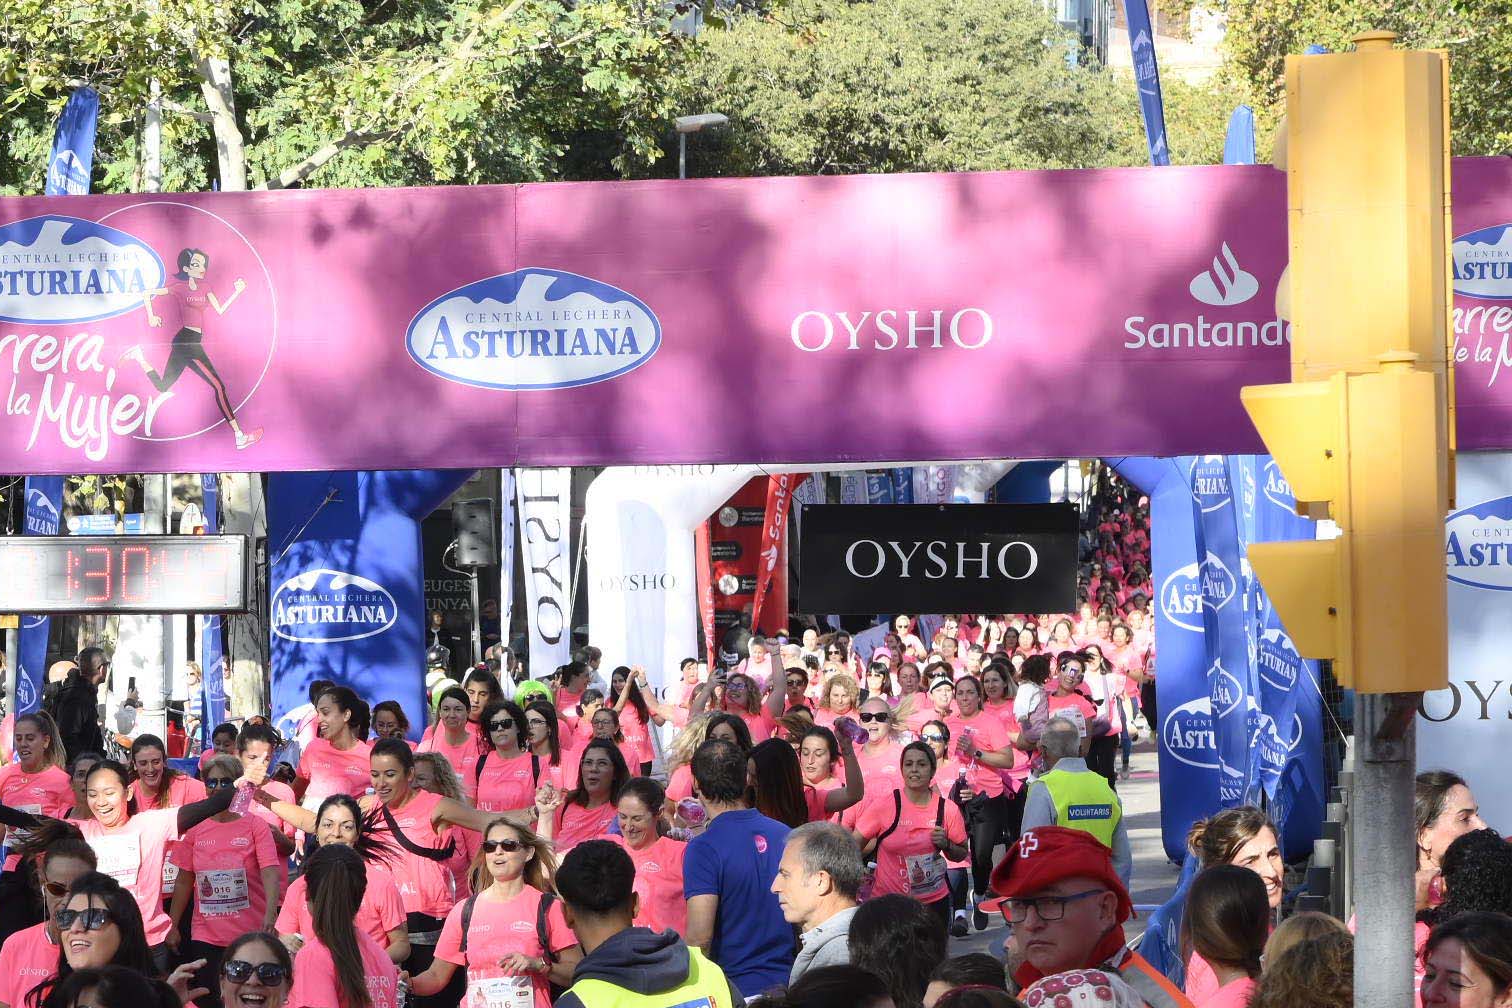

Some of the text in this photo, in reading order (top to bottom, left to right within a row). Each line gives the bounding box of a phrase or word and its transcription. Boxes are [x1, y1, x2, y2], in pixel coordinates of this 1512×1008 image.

[68, 252, 141, 264] LECHERA
[465, 309, 633, 323] CENTRAL LECHERA
[426, 315, 642, 361] ASTURIANA
[790, 308, 993, 352] OYSHO
[6, 381, 31, 416] la
[25, 366, 176, 462] Mujer
[845, 539, 1038, 580] OYSHO
[600, 573, 676, 592] OYSHO
[275, 600, 388, 626] ASTURIANA
[1069, 806, 1111, 819] VOLUNTARIS
[19, 967, 49, 977] OYSHO
